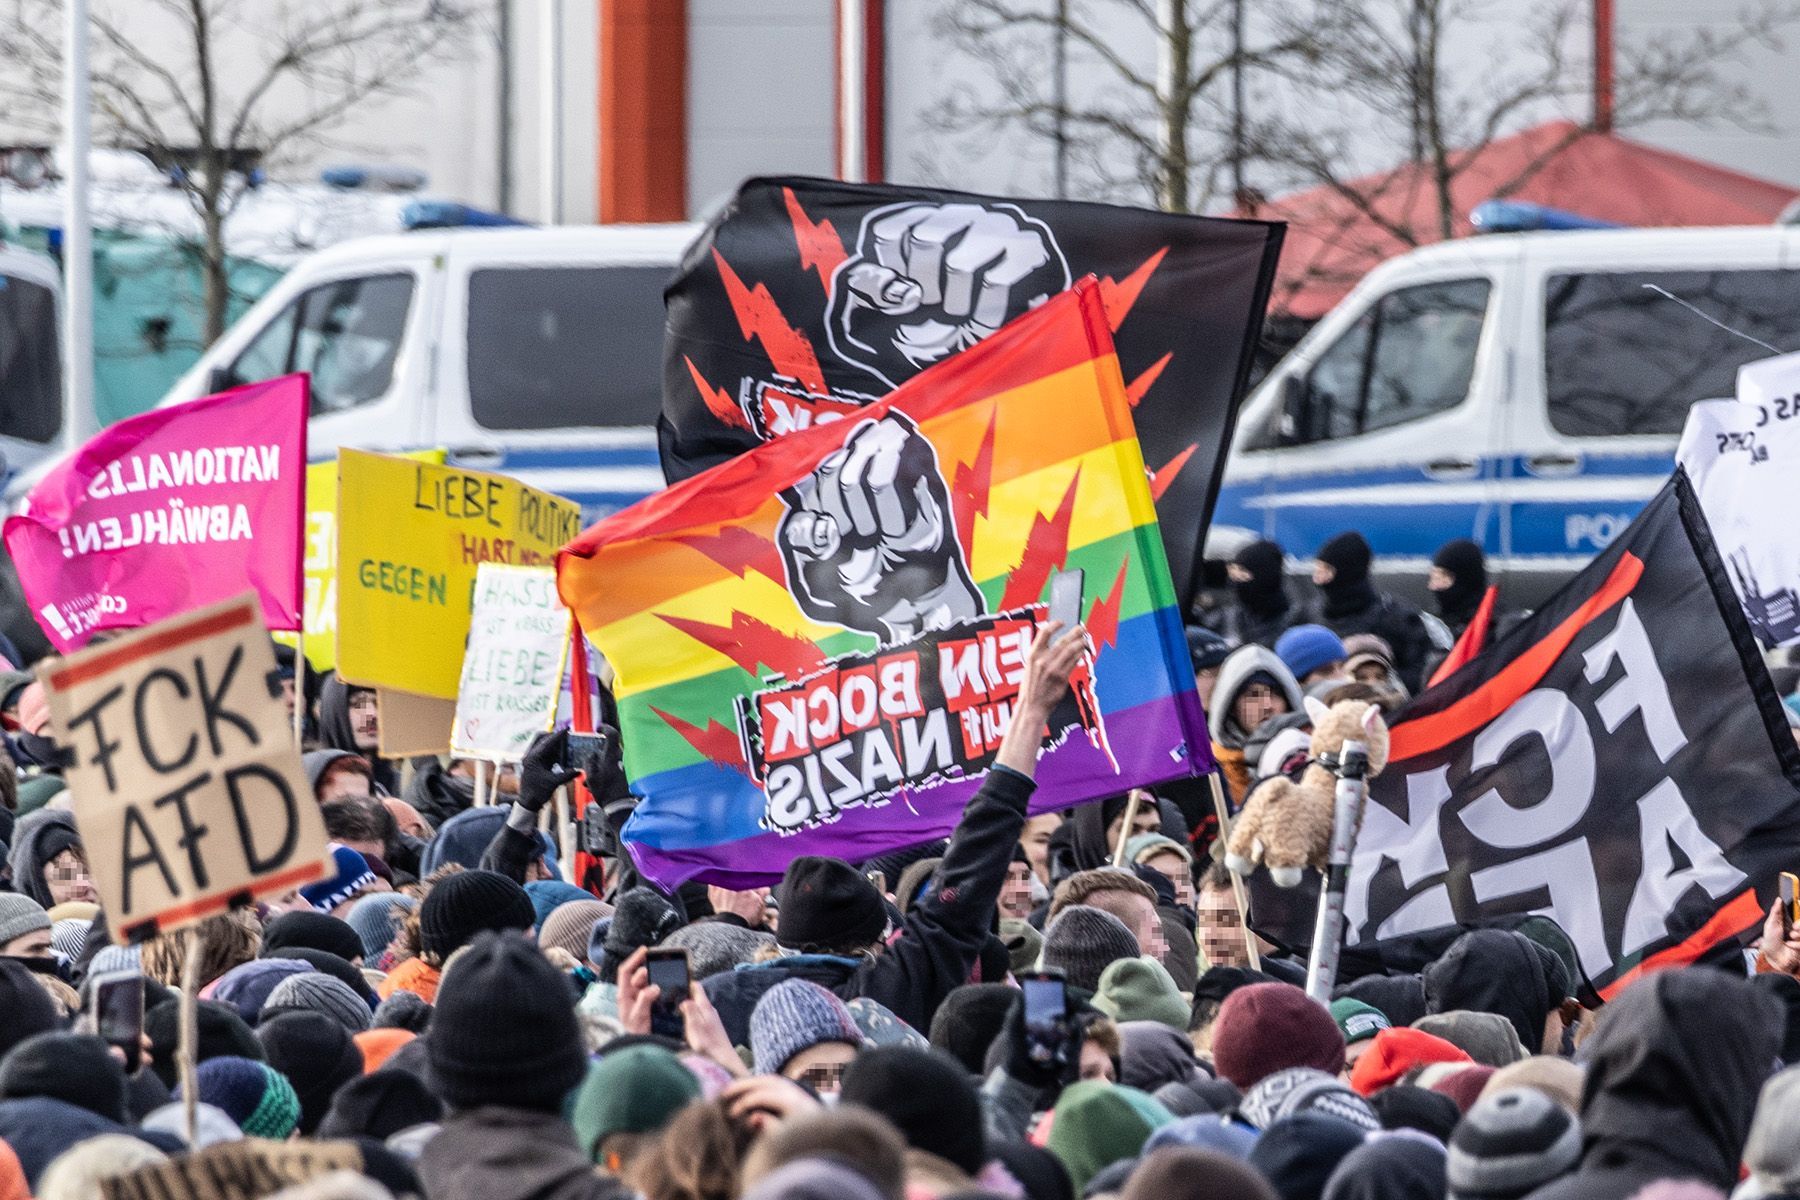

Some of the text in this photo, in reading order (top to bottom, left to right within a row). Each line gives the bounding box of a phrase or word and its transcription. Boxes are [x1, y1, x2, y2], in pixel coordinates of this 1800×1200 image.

[414, 466, 503, 528] LIEBE
[461, 532, 515, 565] HART
[358, 559, 447, 606] GEGEN
[484, 578, 556, 609] HASS
[468, 649, 549, 687] LIEBE
[67, 642, 260, 793] FCK
[121, 763, 300, 915] AFD
